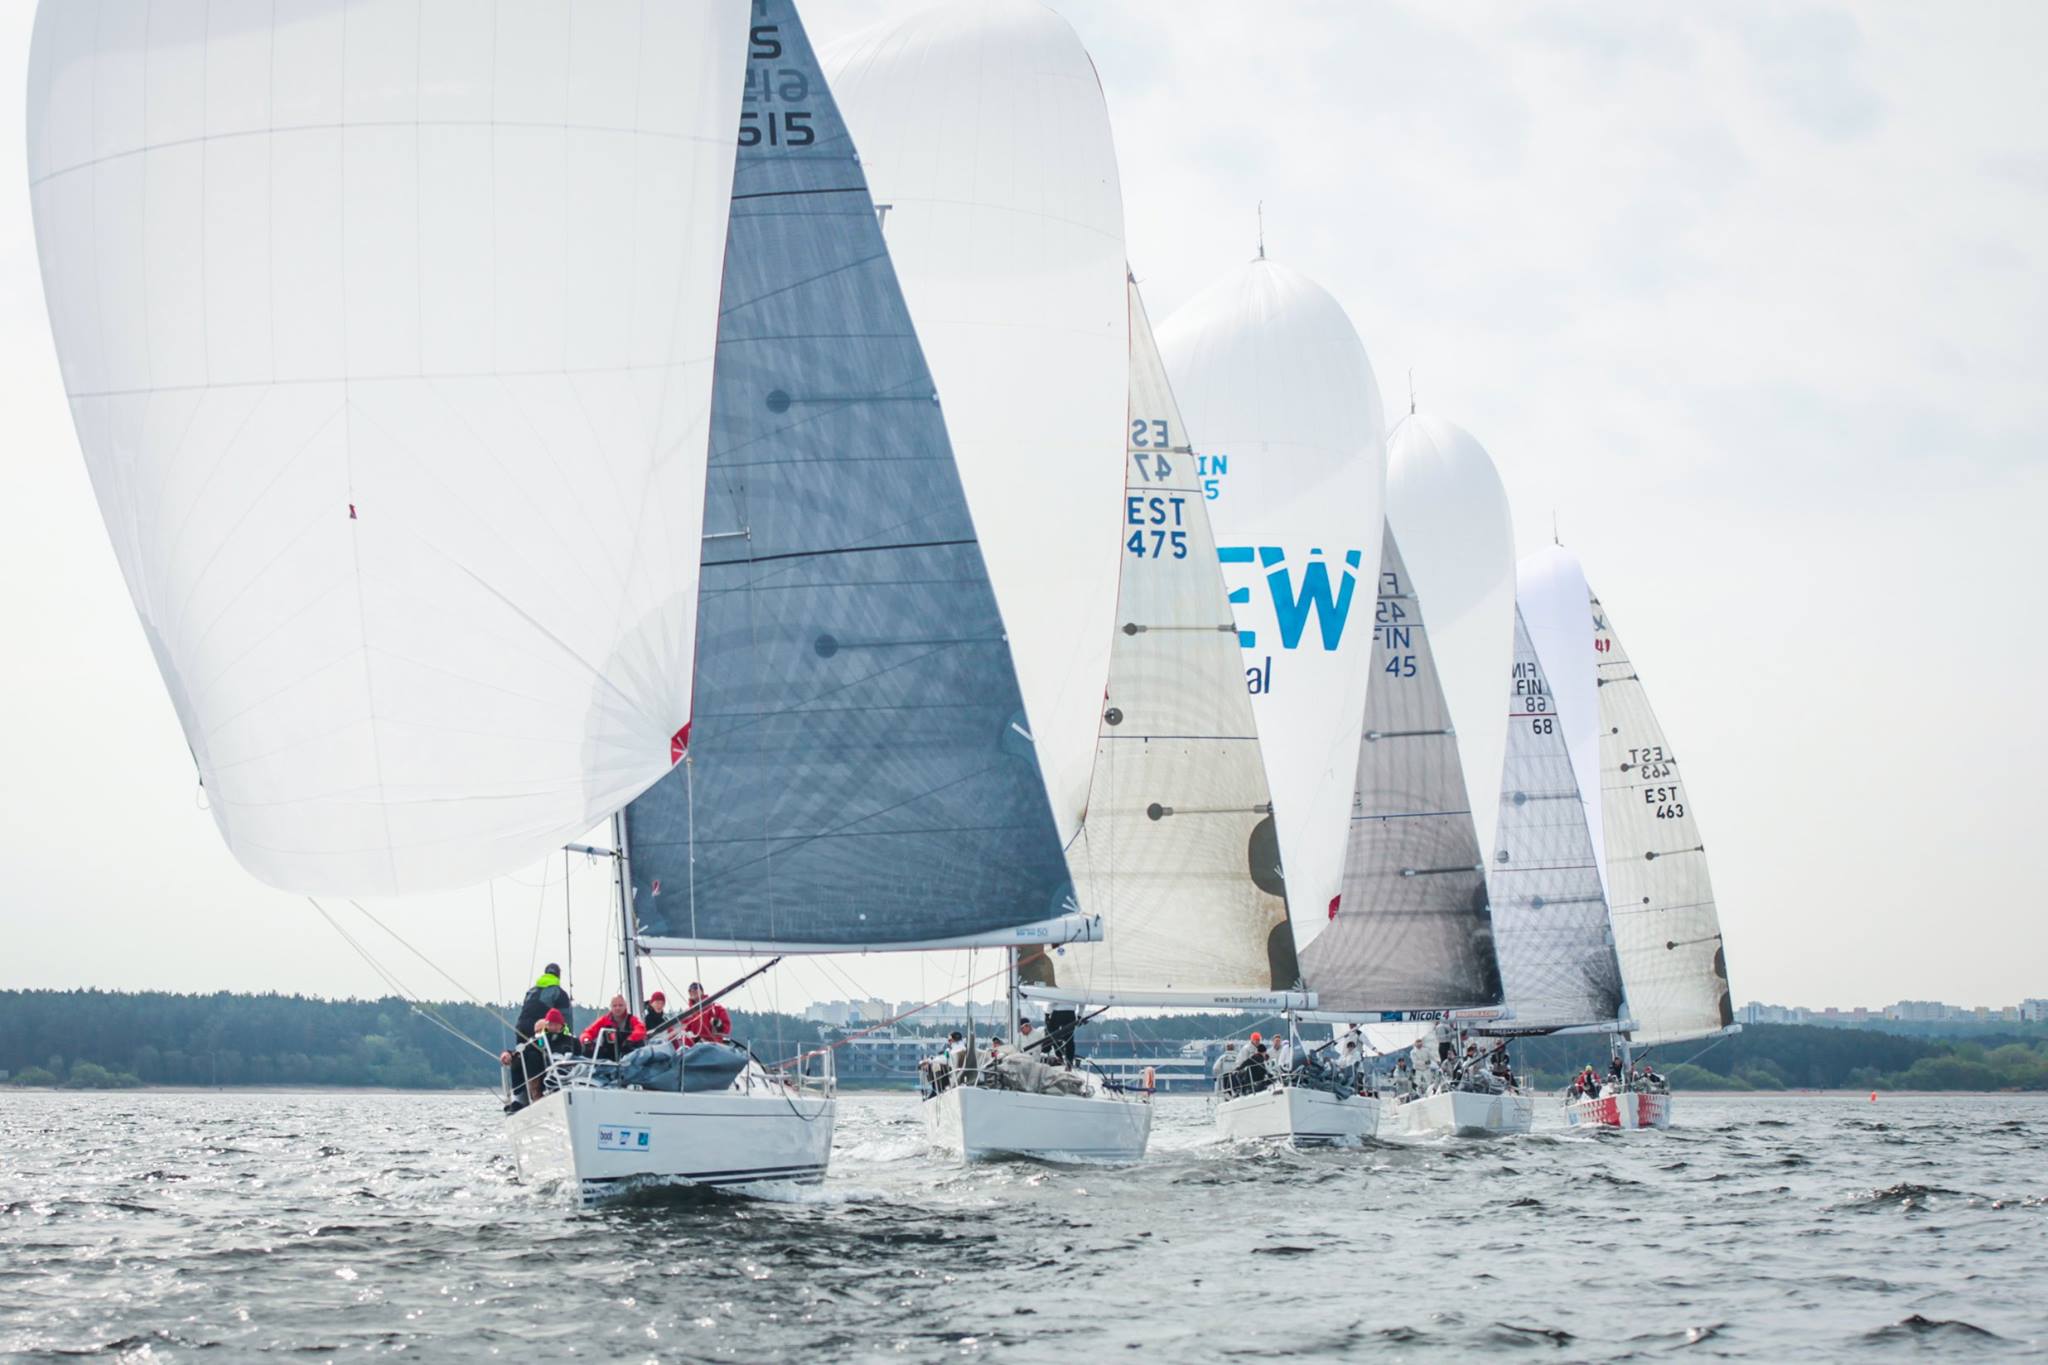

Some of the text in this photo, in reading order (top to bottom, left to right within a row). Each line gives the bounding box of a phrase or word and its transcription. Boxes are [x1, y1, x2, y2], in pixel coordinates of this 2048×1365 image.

[1204, 480, 1220, 500] 5
[1127, 497, 1185, 526] EST
[1126, 530, 1187, 559] 475
[1385, 656, 1416, 678] 45
[1516, 679, 1542, 695] FIN
[1533, 719, 1553, 735] 68
[1644, 786, 1677, 804] EST
[1656, 803, 1684, 820] 463
[1409, 1010, 1441, 1022] Nicole
[1442, 1009, 1450, 1020] 4
